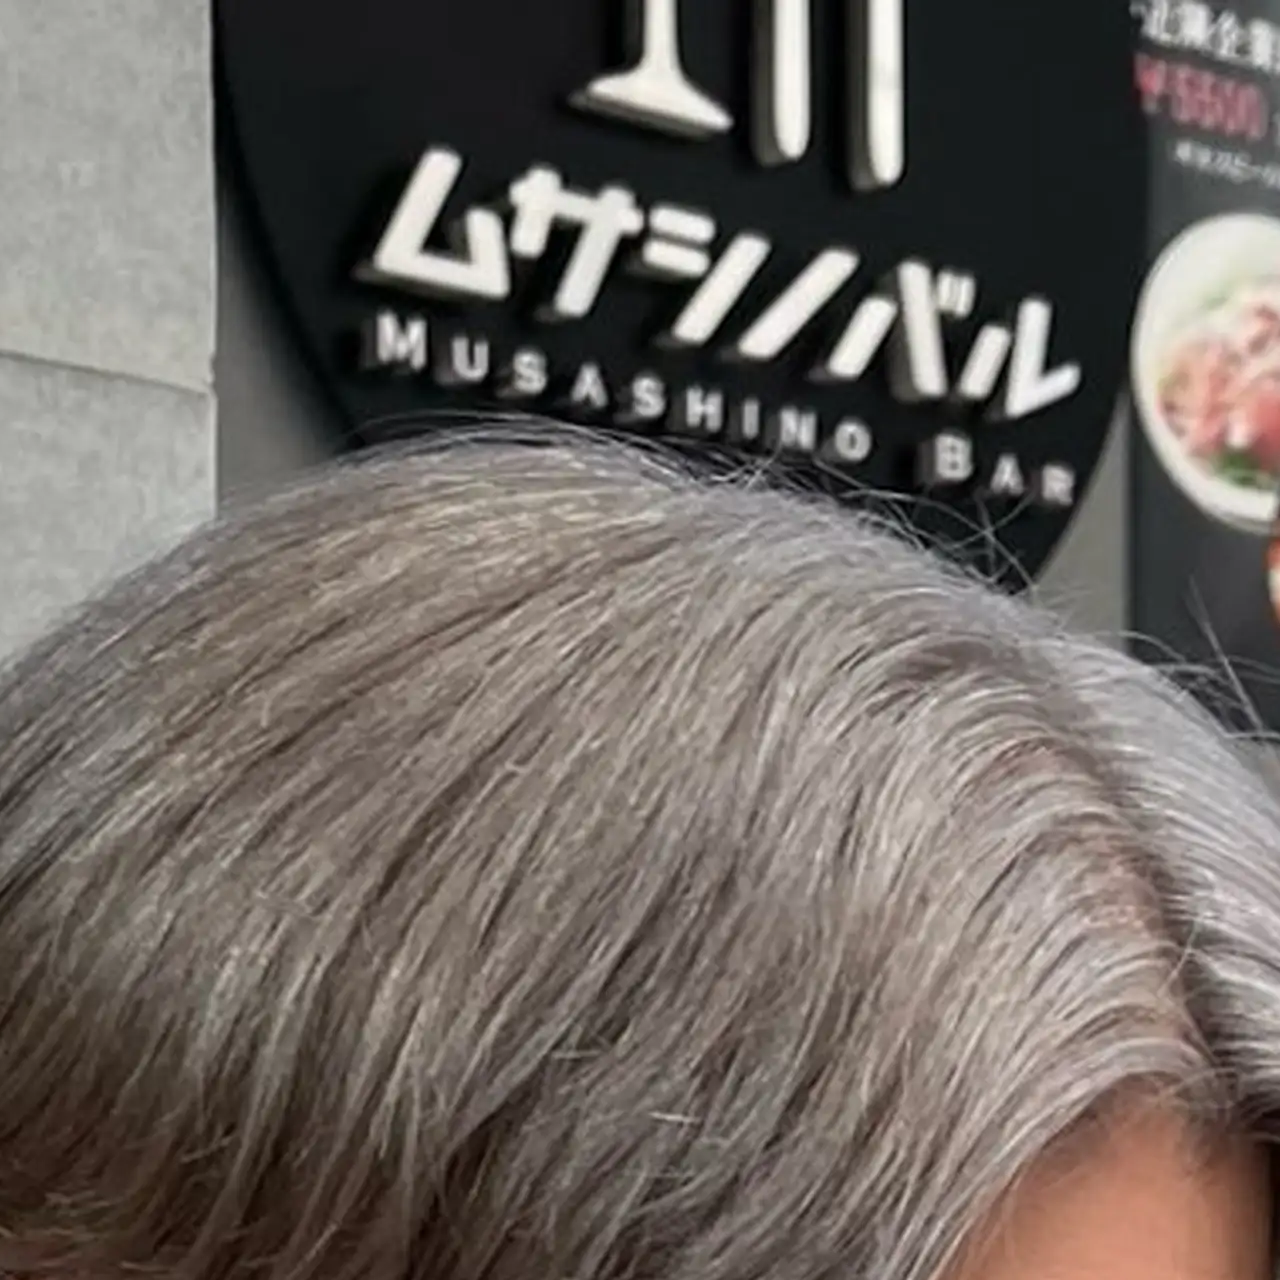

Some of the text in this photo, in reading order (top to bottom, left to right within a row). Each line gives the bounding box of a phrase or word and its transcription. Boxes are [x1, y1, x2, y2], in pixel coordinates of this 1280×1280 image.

[370, 145, 1082, 418] ムサシノバル
[373, 308, 1076, 507] MUSASHINO BAR
